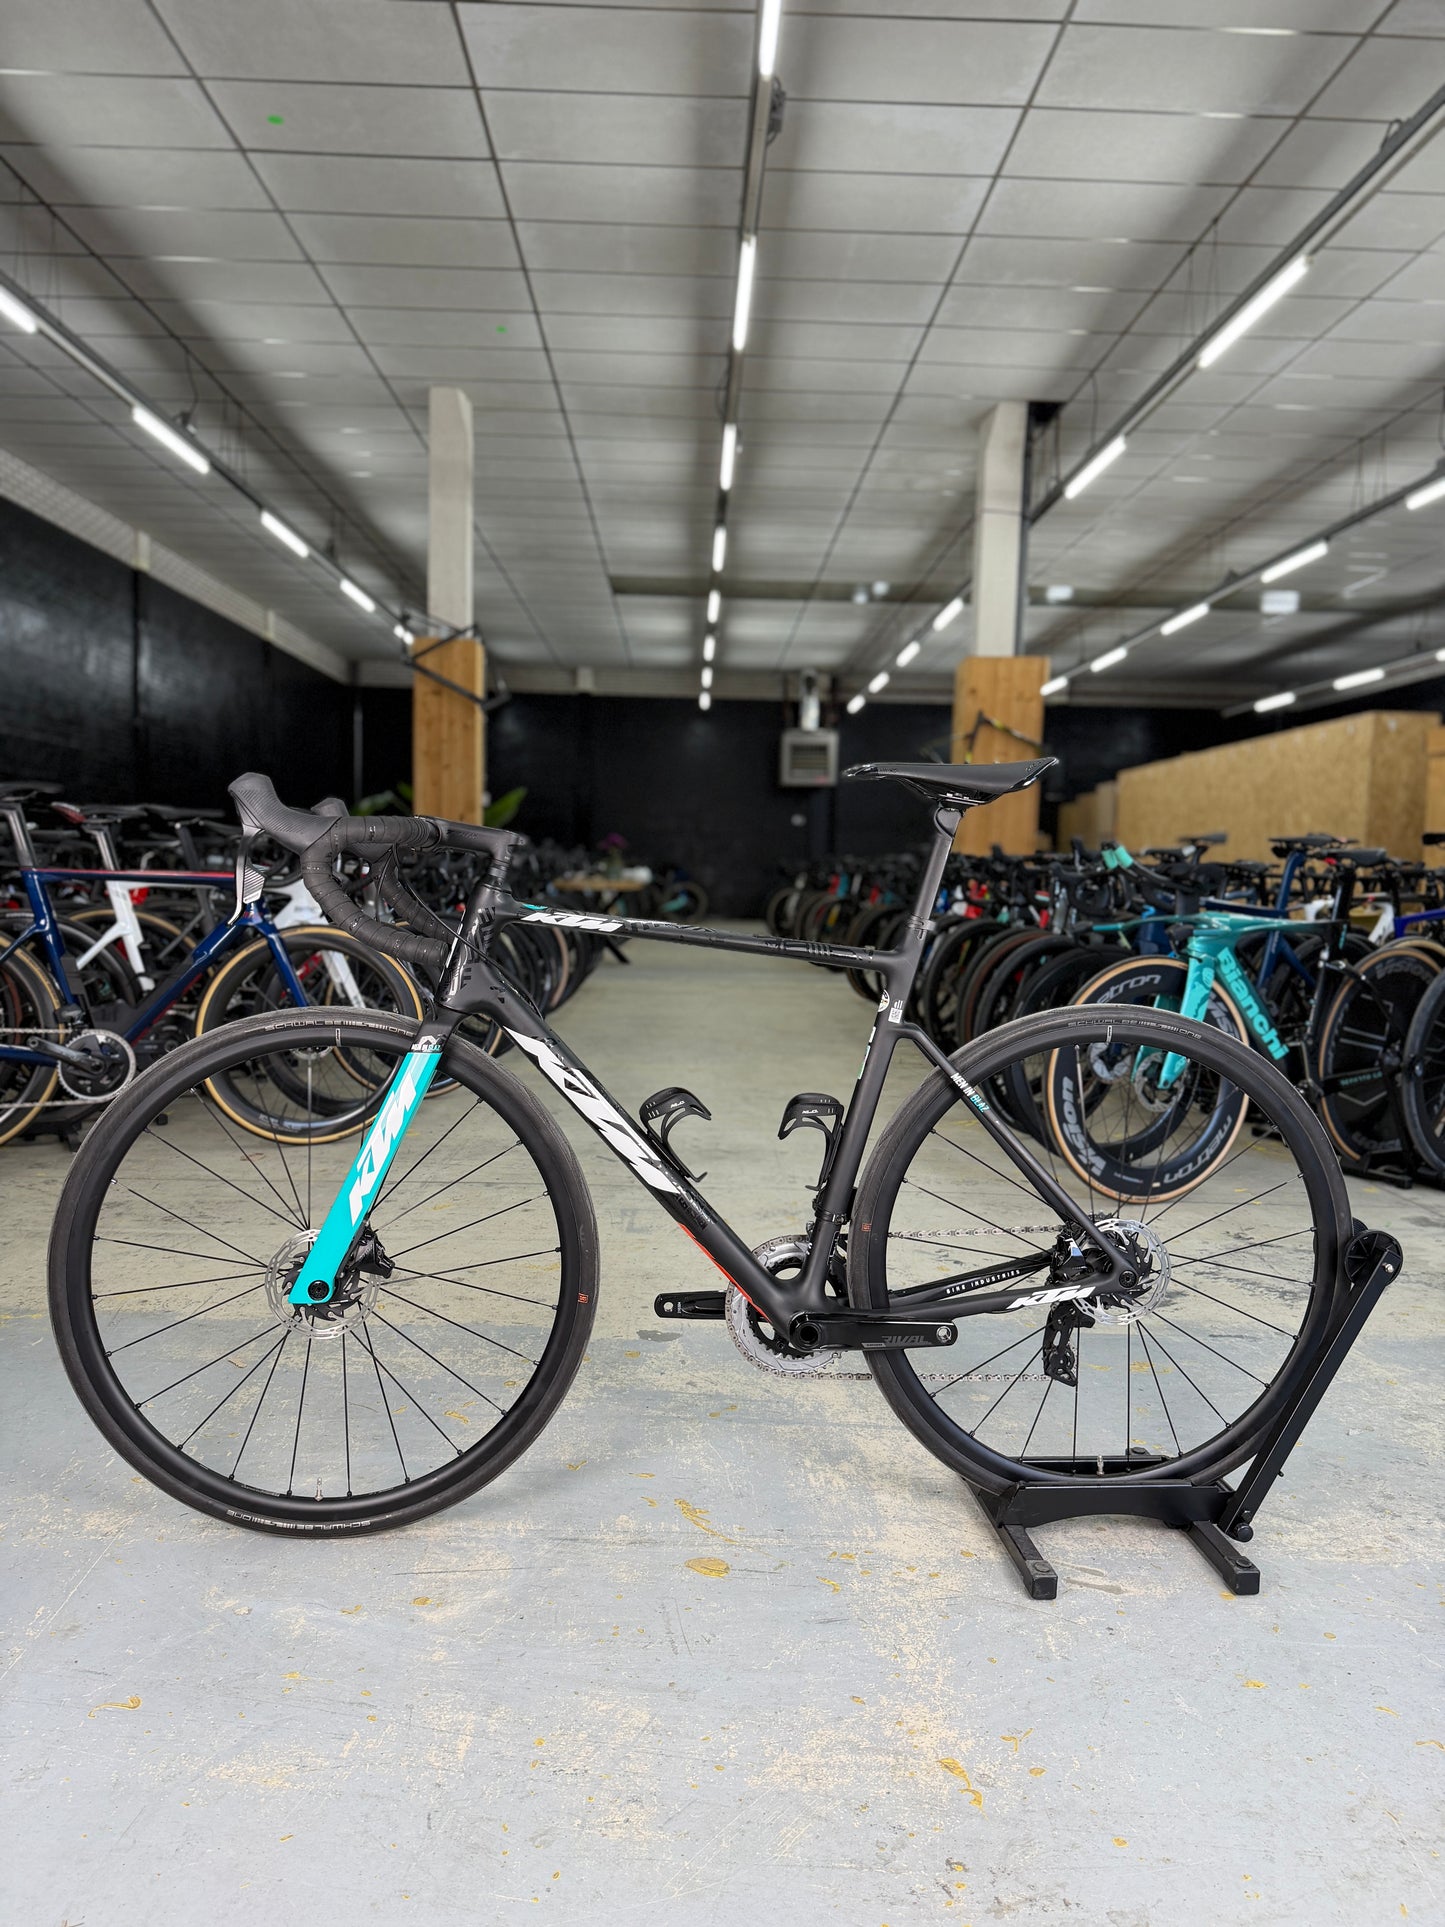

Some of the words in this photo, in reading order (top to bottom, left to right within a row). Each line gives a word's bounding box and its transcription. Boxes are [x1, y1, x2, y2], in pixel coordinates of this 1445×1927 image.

[1216, 947, 1290, 1060] Bianchi
[265, 1019, 340, 1032] SCHWALBE
[950, 1072, 969, 1089] MEN
[962, 1086, 976, 1097] IN
[1163, 1115, 1233, 1184] metron
[945, 1284, 967, 1295] BIKE
[970, 1269, 1021, 1288] INDUSTRIES
[881, 1335, 929, 1346] RIVAL
[296, 1520, 371, 1531] SCHWALBE
